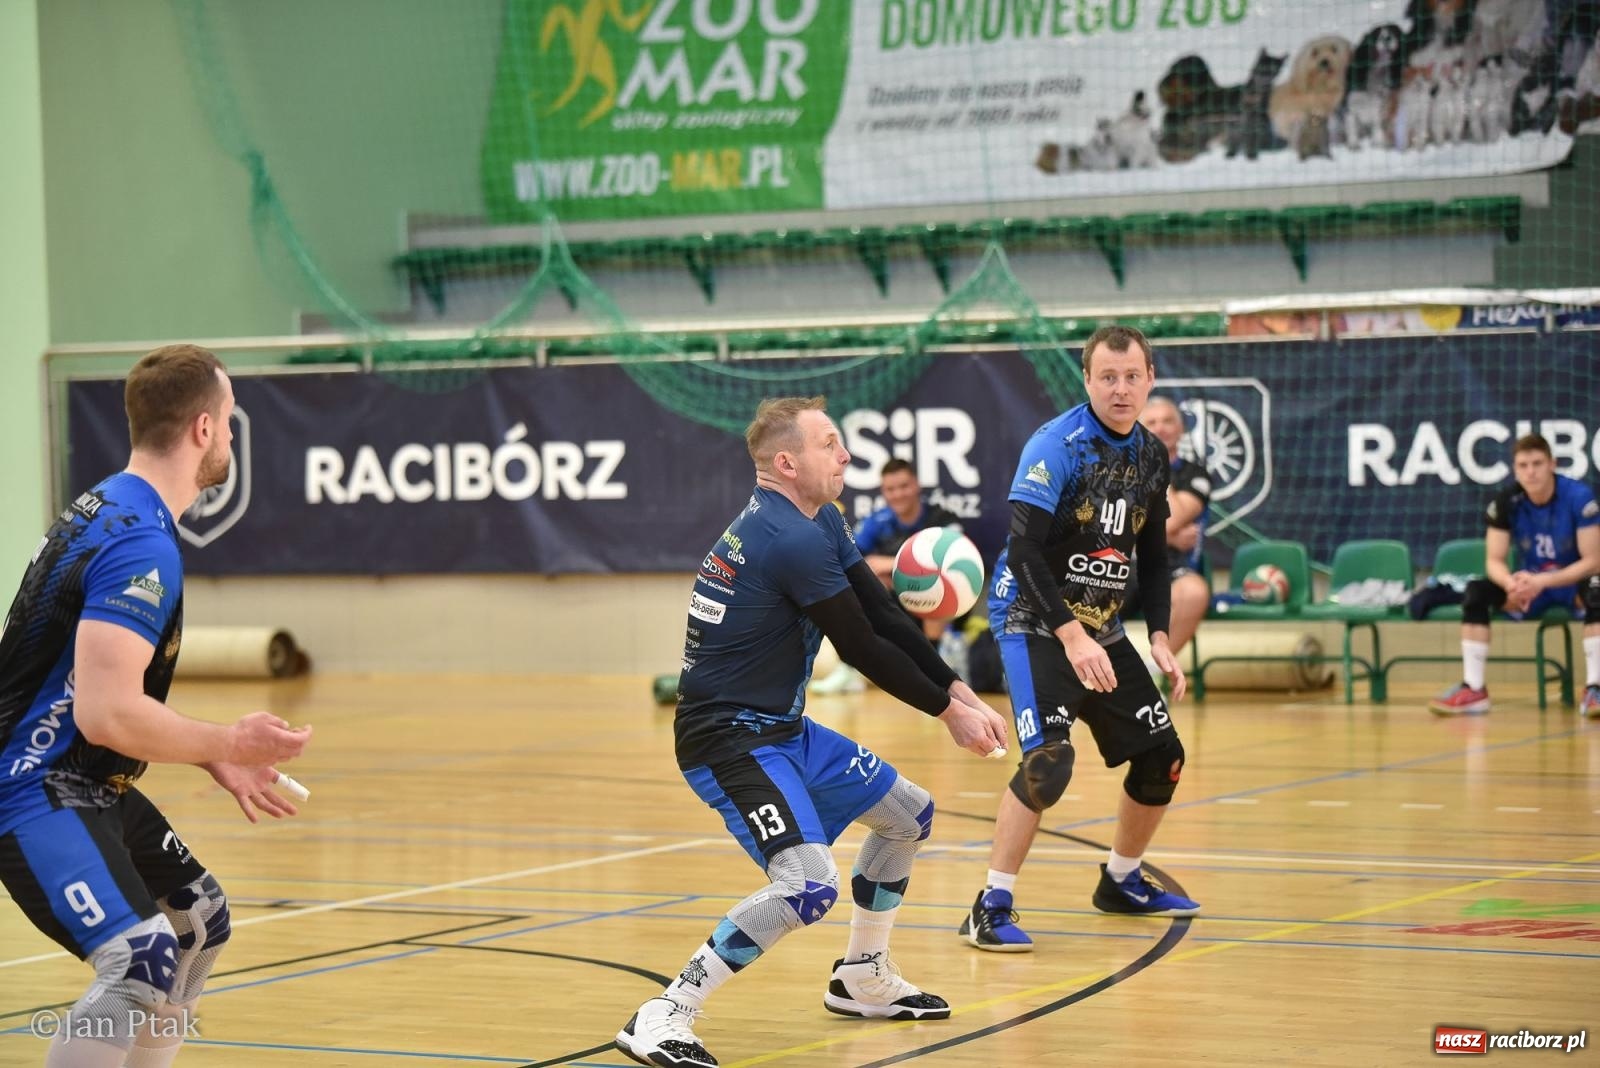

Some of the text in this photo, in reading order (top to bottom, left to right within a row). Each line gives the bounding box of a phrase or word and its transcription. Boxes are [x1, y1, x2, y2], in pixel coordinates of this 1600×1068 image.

[639, 0, 821, 43] ZOO
[615, 38, 808, 108] MAR
[612, 111, 669, 131] sklep
[513, 144, 789, 201] WWW.ZOO-MAR.PL
[305, 420, 628, 504] RACIBÓRZ
[1100, 498, 1127, 536] 40
[727, 550, 746, 565] club
[1068, 553, 1130, 580] GOLD
[130, 575, 165, 598] LASEL
[1065, 572, 1127, 591] POKRYCIA DACHOWE
[749, 803, 787, 841] 13
[63, 881, 106, 927] 9
